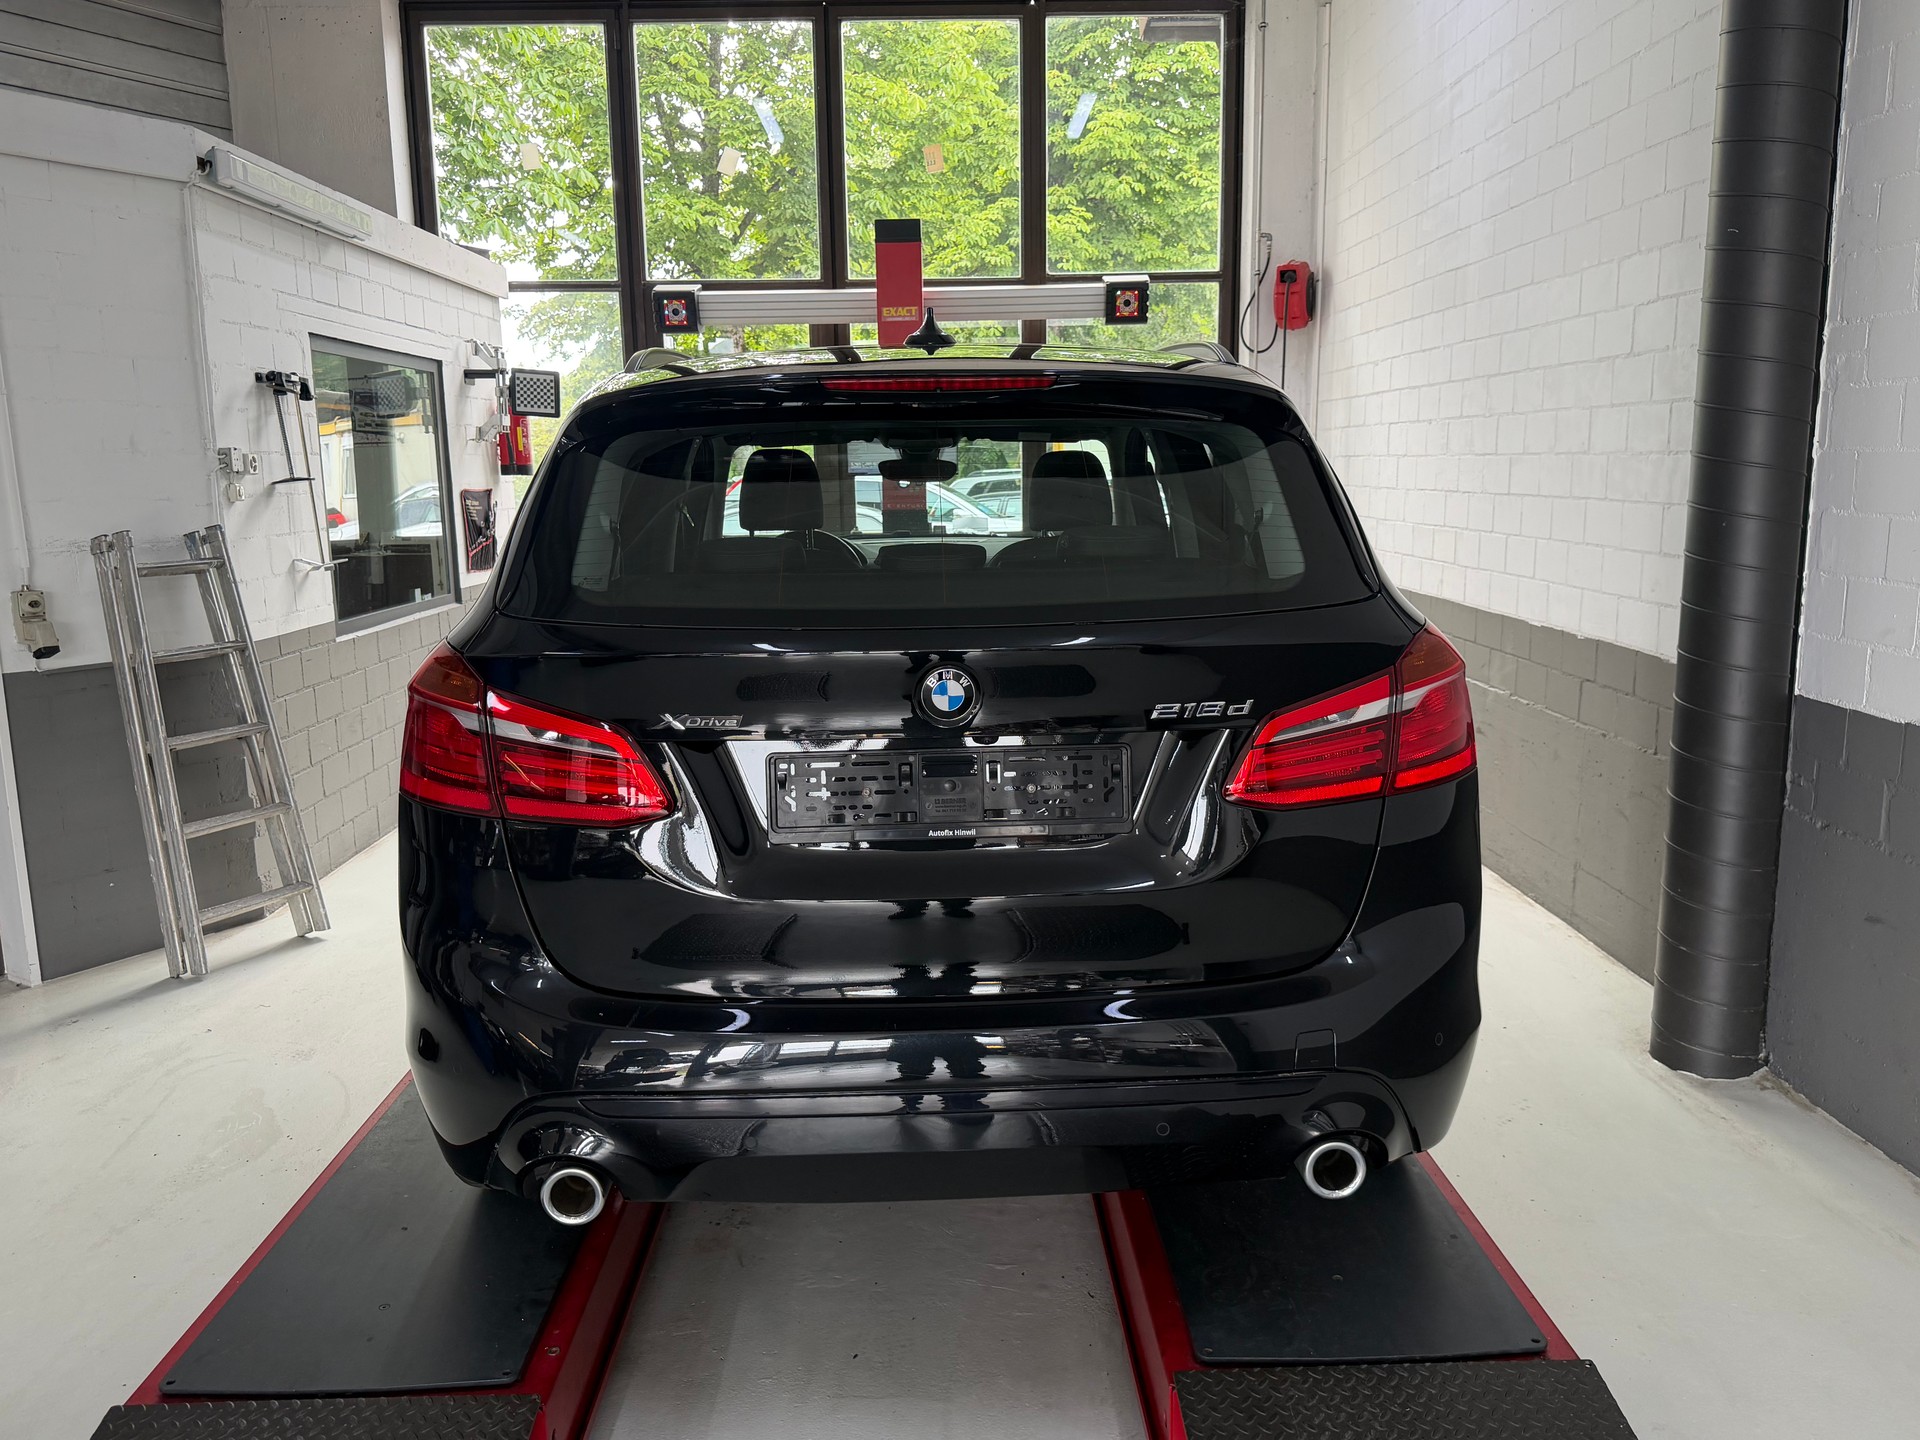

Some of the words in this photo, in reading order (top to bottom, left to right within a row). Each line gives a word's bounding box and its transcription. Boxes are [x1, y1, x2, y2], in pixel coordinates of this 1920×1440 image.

[883, 307, 918, 317] EXACT
[926, 670, 971, 688] BMW
[1151, 699, 1254, 720] 218d
[928, 829, 954, 837] Autofix
[954, 828, 976, 836] Hinwil
